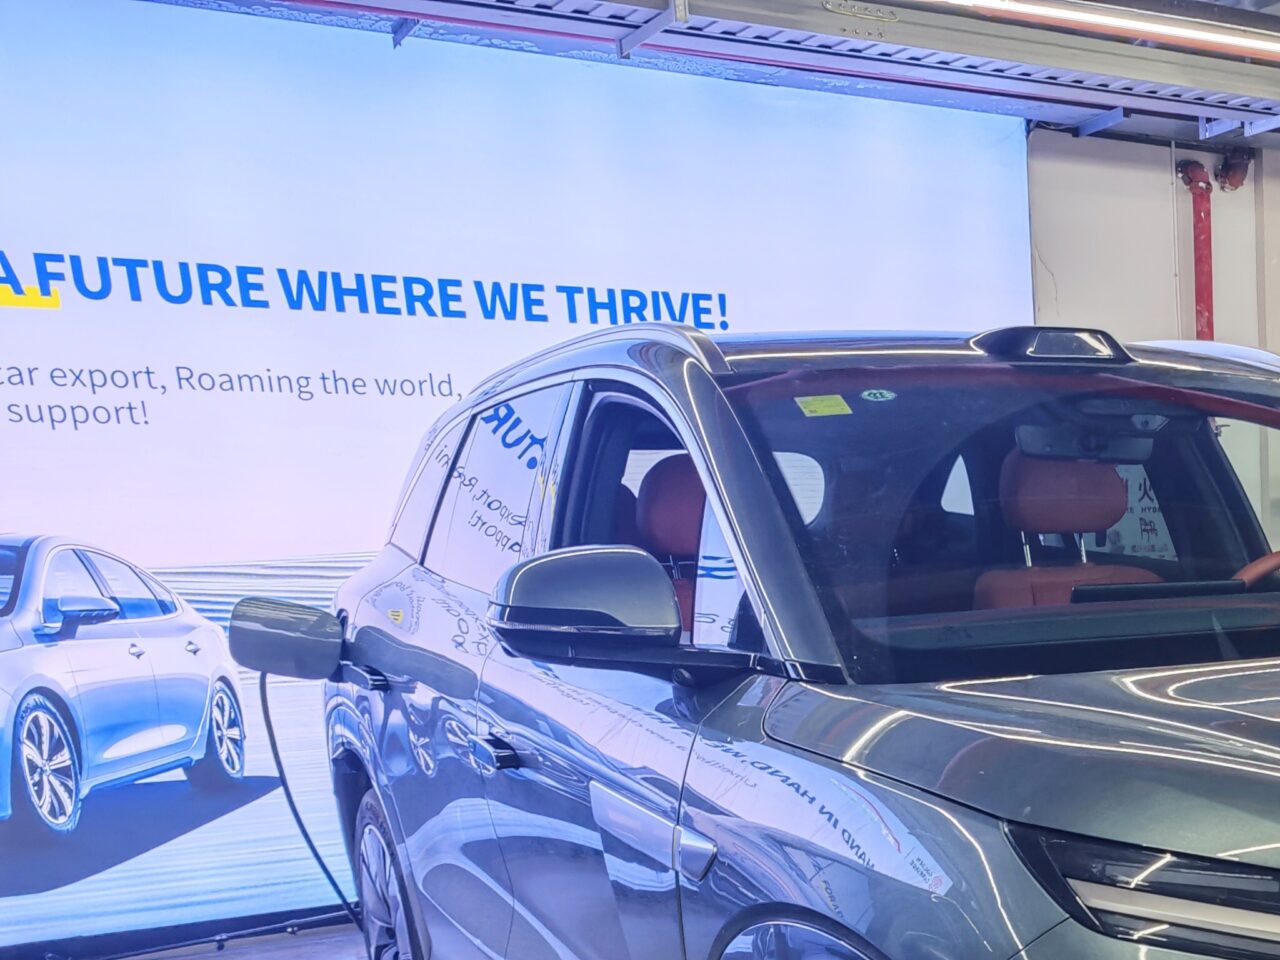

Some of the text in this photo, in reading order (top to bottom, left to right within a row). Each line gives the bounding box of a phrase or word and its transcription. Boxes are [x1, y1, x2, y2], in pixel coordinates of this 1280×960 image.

[33, 252, 270, 309] FUTURE
[276, 268, 466, 318] WHERE
[473, 280, 548, 322] WE
[556, 285, 729, 331] THRIVE!
[50, 366, 167, 395] export,
[176, 365, 314, 401] Roaming
[319, 369, 368, 395] the
[375, 372, 463, 402] world,
[7, 400, 150, 431] support!
